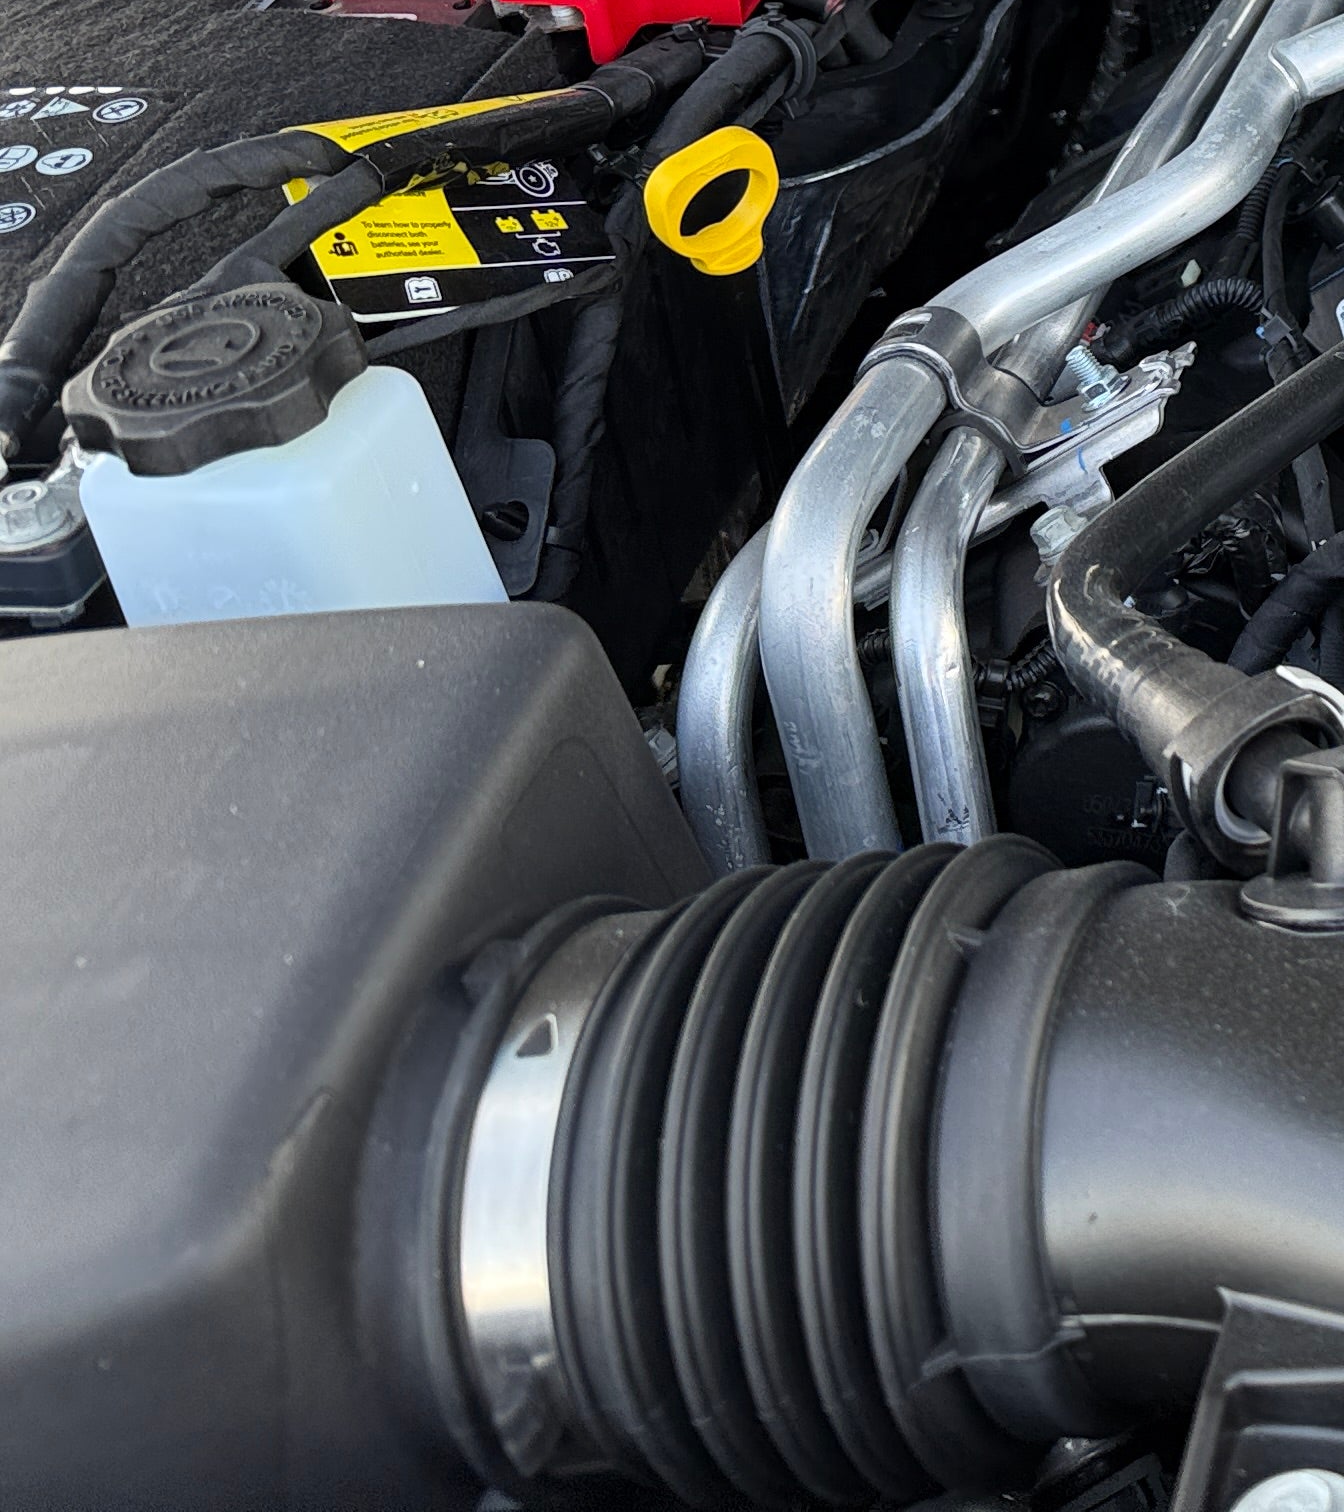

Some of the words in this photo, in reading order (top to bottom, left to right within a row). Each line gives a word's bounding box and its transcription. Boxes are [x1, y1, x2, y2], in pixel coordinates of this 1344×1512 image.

[374, 221, 392, 229] learn
[420, 221, 452, 229] properly
[367, 231, 408, 239] disconnect
[422, 241, 439, 249] your
